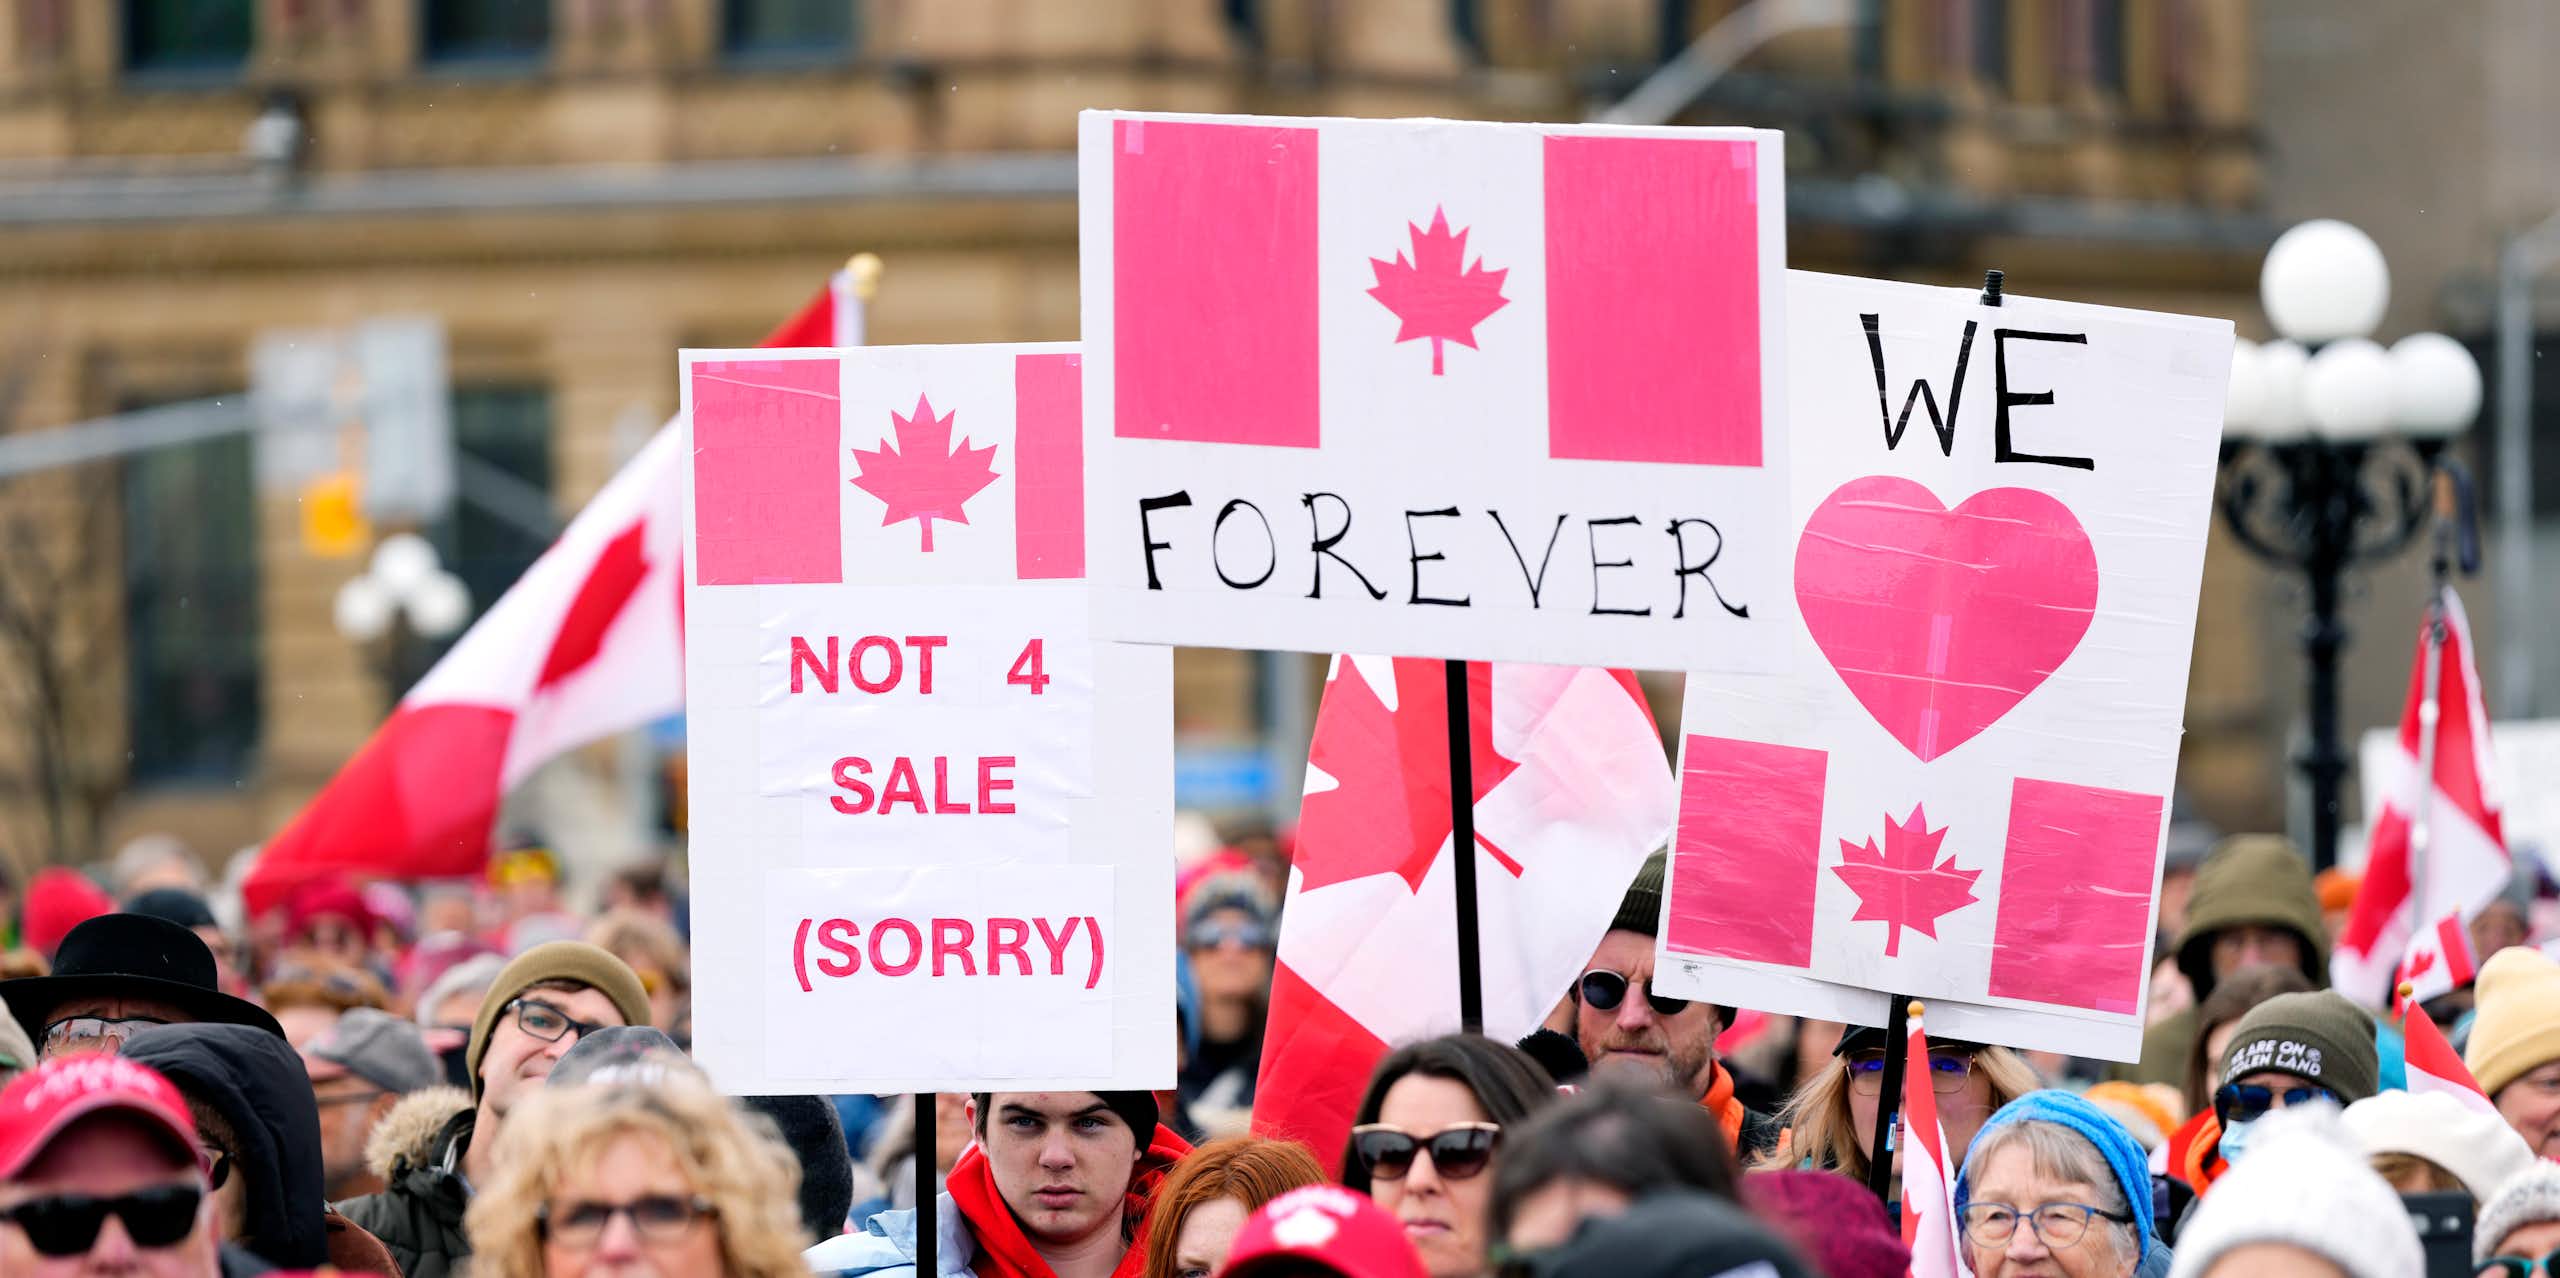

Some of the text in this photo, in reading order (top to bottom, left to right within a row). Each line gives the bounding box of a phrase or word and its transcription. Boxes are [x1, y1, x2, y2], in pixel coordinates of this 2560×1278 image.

[1860, 313, 2094, 471] WE
[1139, 490, 1749, 619] FOREVER
[790, 635, 1051, 695] NOT 4
[830, 755, 1017, 815] SALE
[793, 916, 1105, 993] (SORRY)
[2247, 1040, 2277, 1056] ARE
[2279, 1041, 2306, 1057] ON
[2275, 1054, 2321, 1077] LAND
